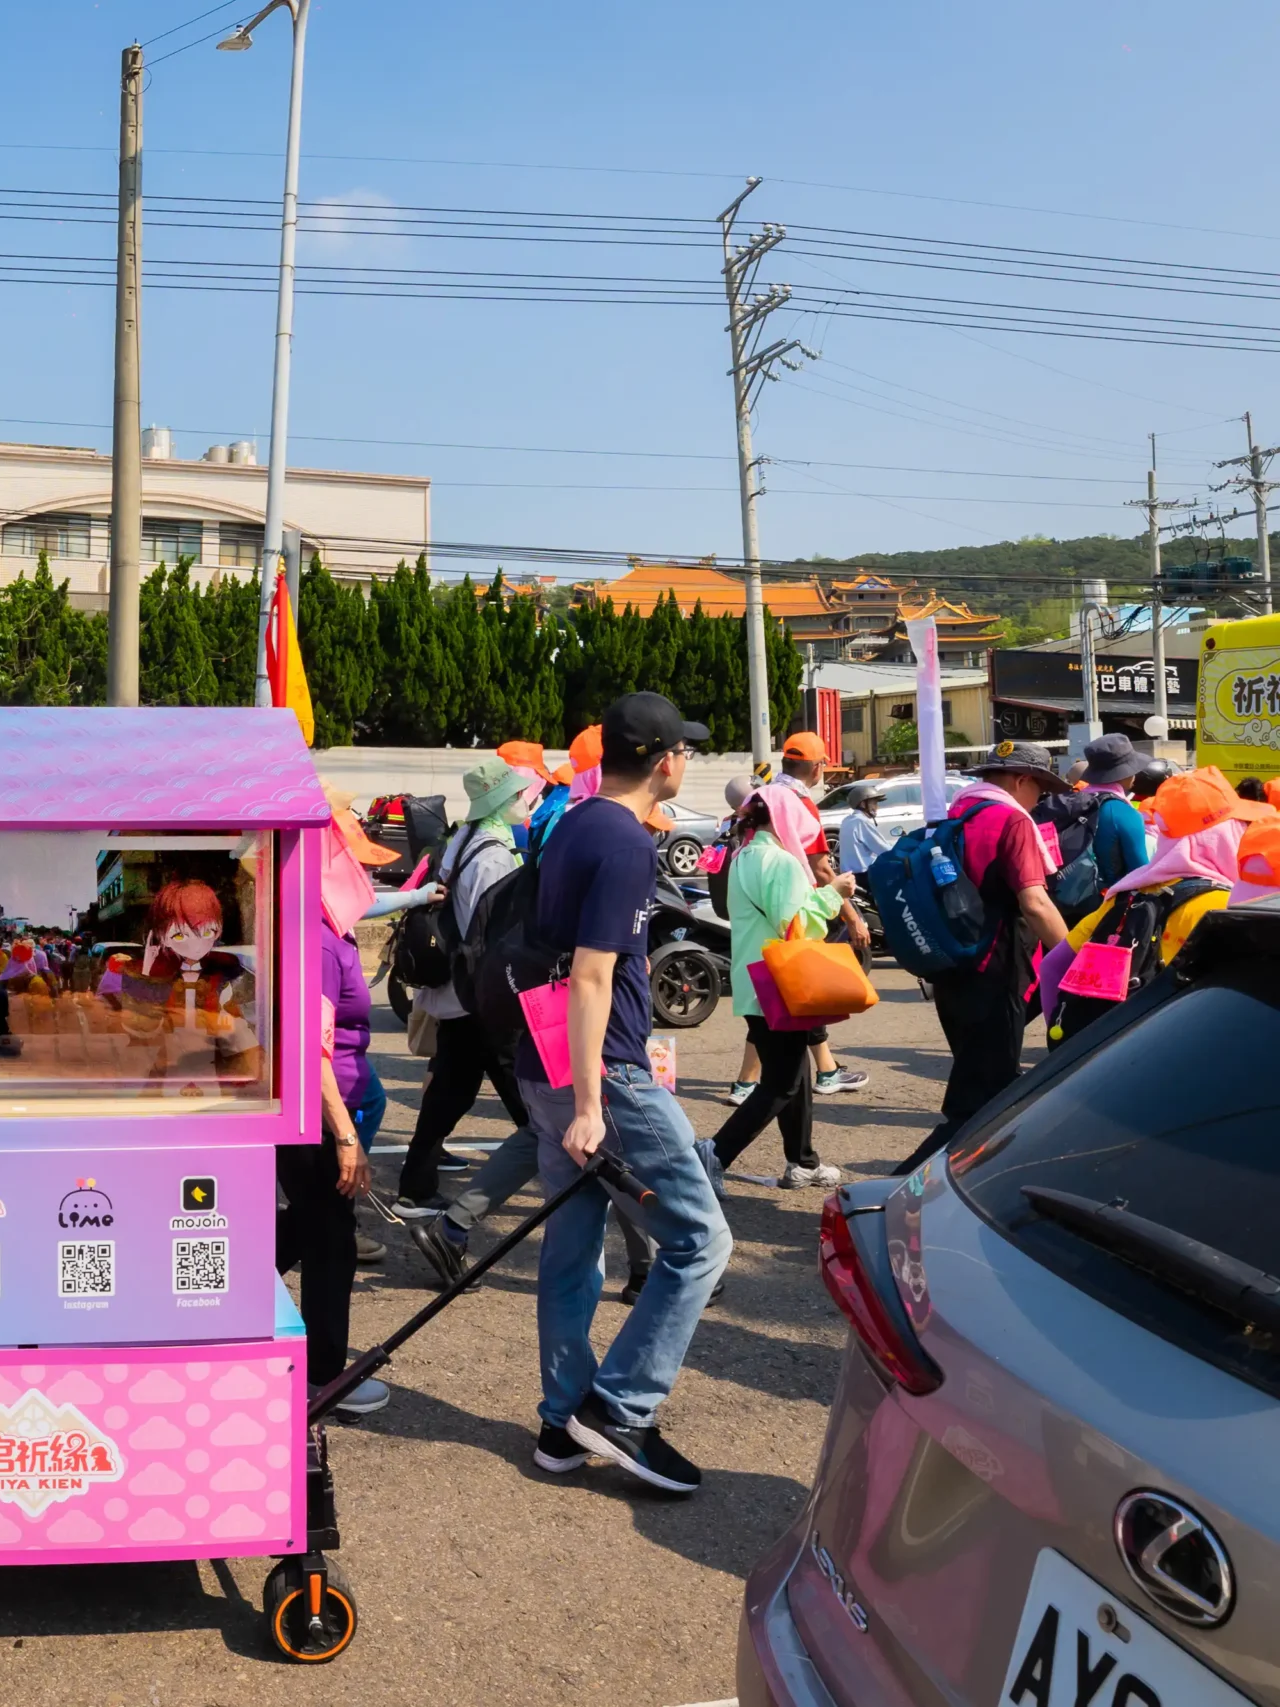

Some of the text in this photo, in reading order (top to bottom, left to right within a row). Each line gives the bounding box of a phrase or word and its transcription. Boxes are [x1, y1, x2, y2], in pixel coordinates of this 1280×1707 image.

[1095, 674, 1180, 694] 巴車體藝
[902, 905, 932, 955] VICTOR
[63, 1300, 110, 1311] Instagram
[176, 1297, 221, 1308] Facebook
[38, 1477, 83, 1490] KIEN
